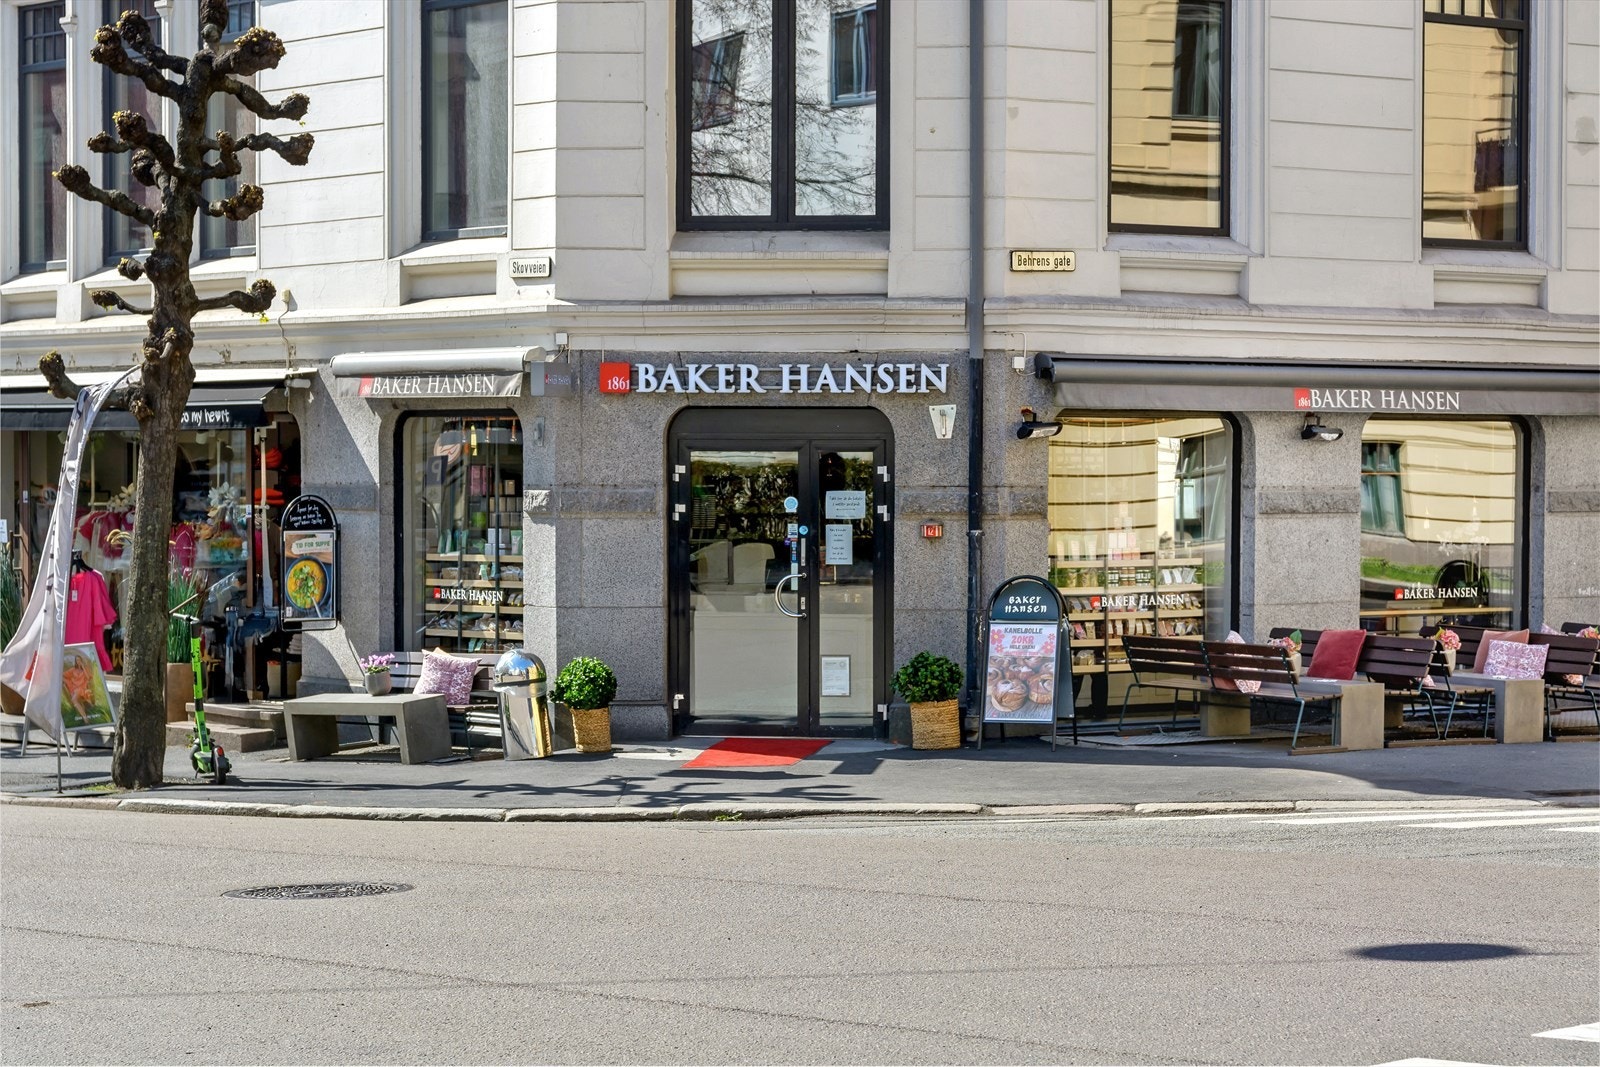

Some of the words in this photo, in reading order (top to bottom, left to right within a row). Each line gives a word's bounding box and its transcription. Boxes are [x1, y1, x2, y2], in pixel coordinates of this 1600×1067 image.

[512, 260, 547, 274] Skovveien
[1017, 254, 1051, 267] Behrens
[1053, 255, 1071, 269] gate
[372, 375, 421, 395] BAKER
[427, 373, 495, 394] HANSEN
[607, 376, 631, 390] 1861
[634, 363, 767, 393] BAKER
[778, 363, 949, 394] HANSEN
[1310, 389, 1376, 409] BAKER
[1380, 390, 1460, 410] HANSEN
[441, 588, 467, 600] BAKER
[469, 589, 503, 602] HANSEN
[1101, 595, 1136, 607] BAKER
[1140, 594, 1185, 606] HANSEN
[1404, 588, 1436, 600] BAKER
[1438, 587, 1478, 599] HANSEN
[1004, 627, 1043, 635] KANELBOLLE
[1011, 635, 1035, 645] 20KR
